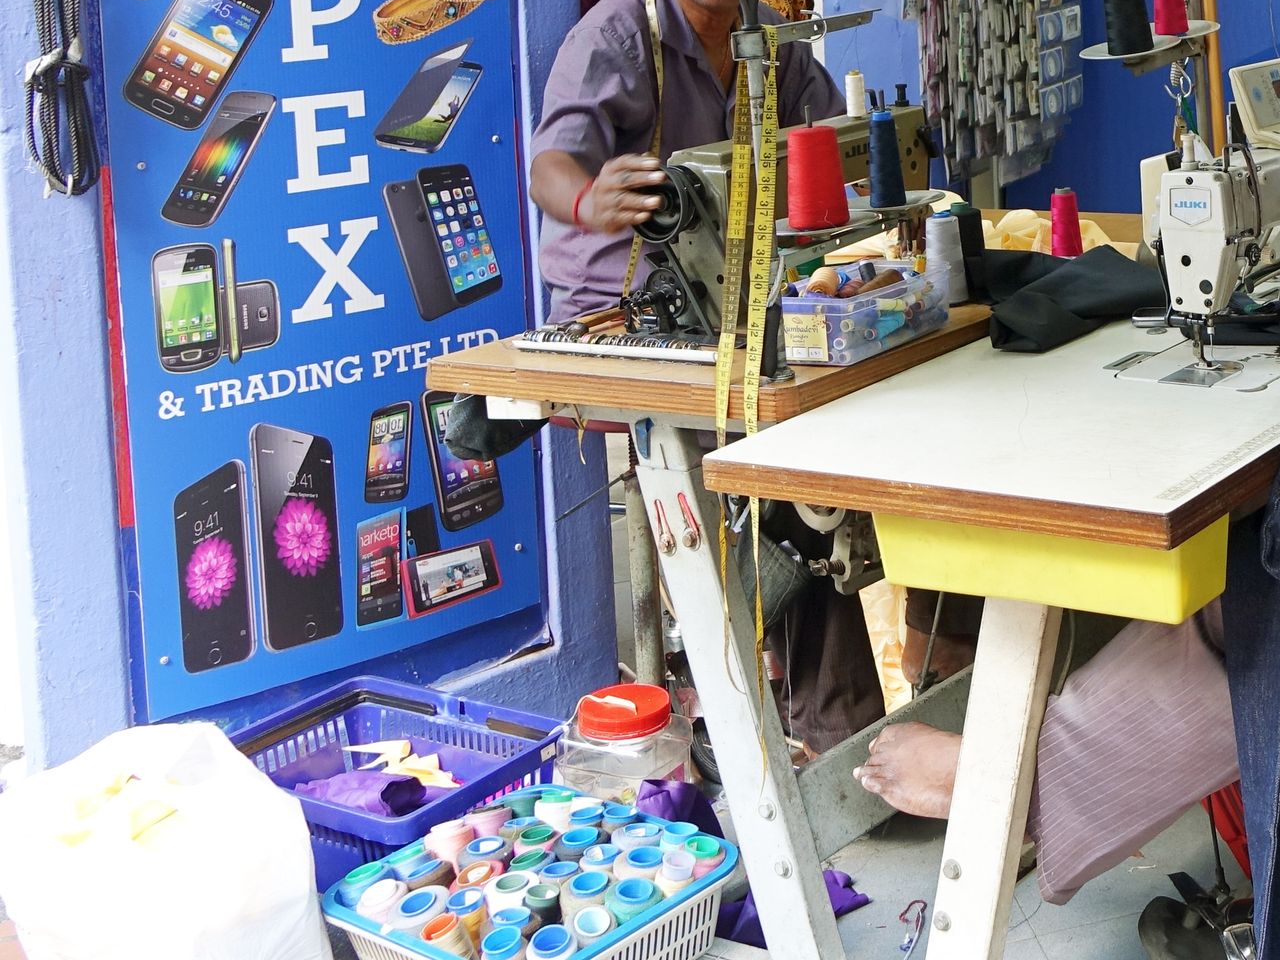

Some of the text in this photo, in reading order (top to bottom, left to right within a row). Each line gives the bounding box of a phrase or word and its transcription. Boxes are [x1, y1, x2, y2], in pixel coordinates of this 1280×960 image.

[845, 142, 871, 159] JU
[1174, 200, 1208, 209] JUKI
[158, 390, 185, 421] &
[196, 358, 364, 413] TRADING
[372, 341, 433, 379] PTE
[287, 471, 314, 489] 9:41
[193, 511, 220, 537] 9:41
